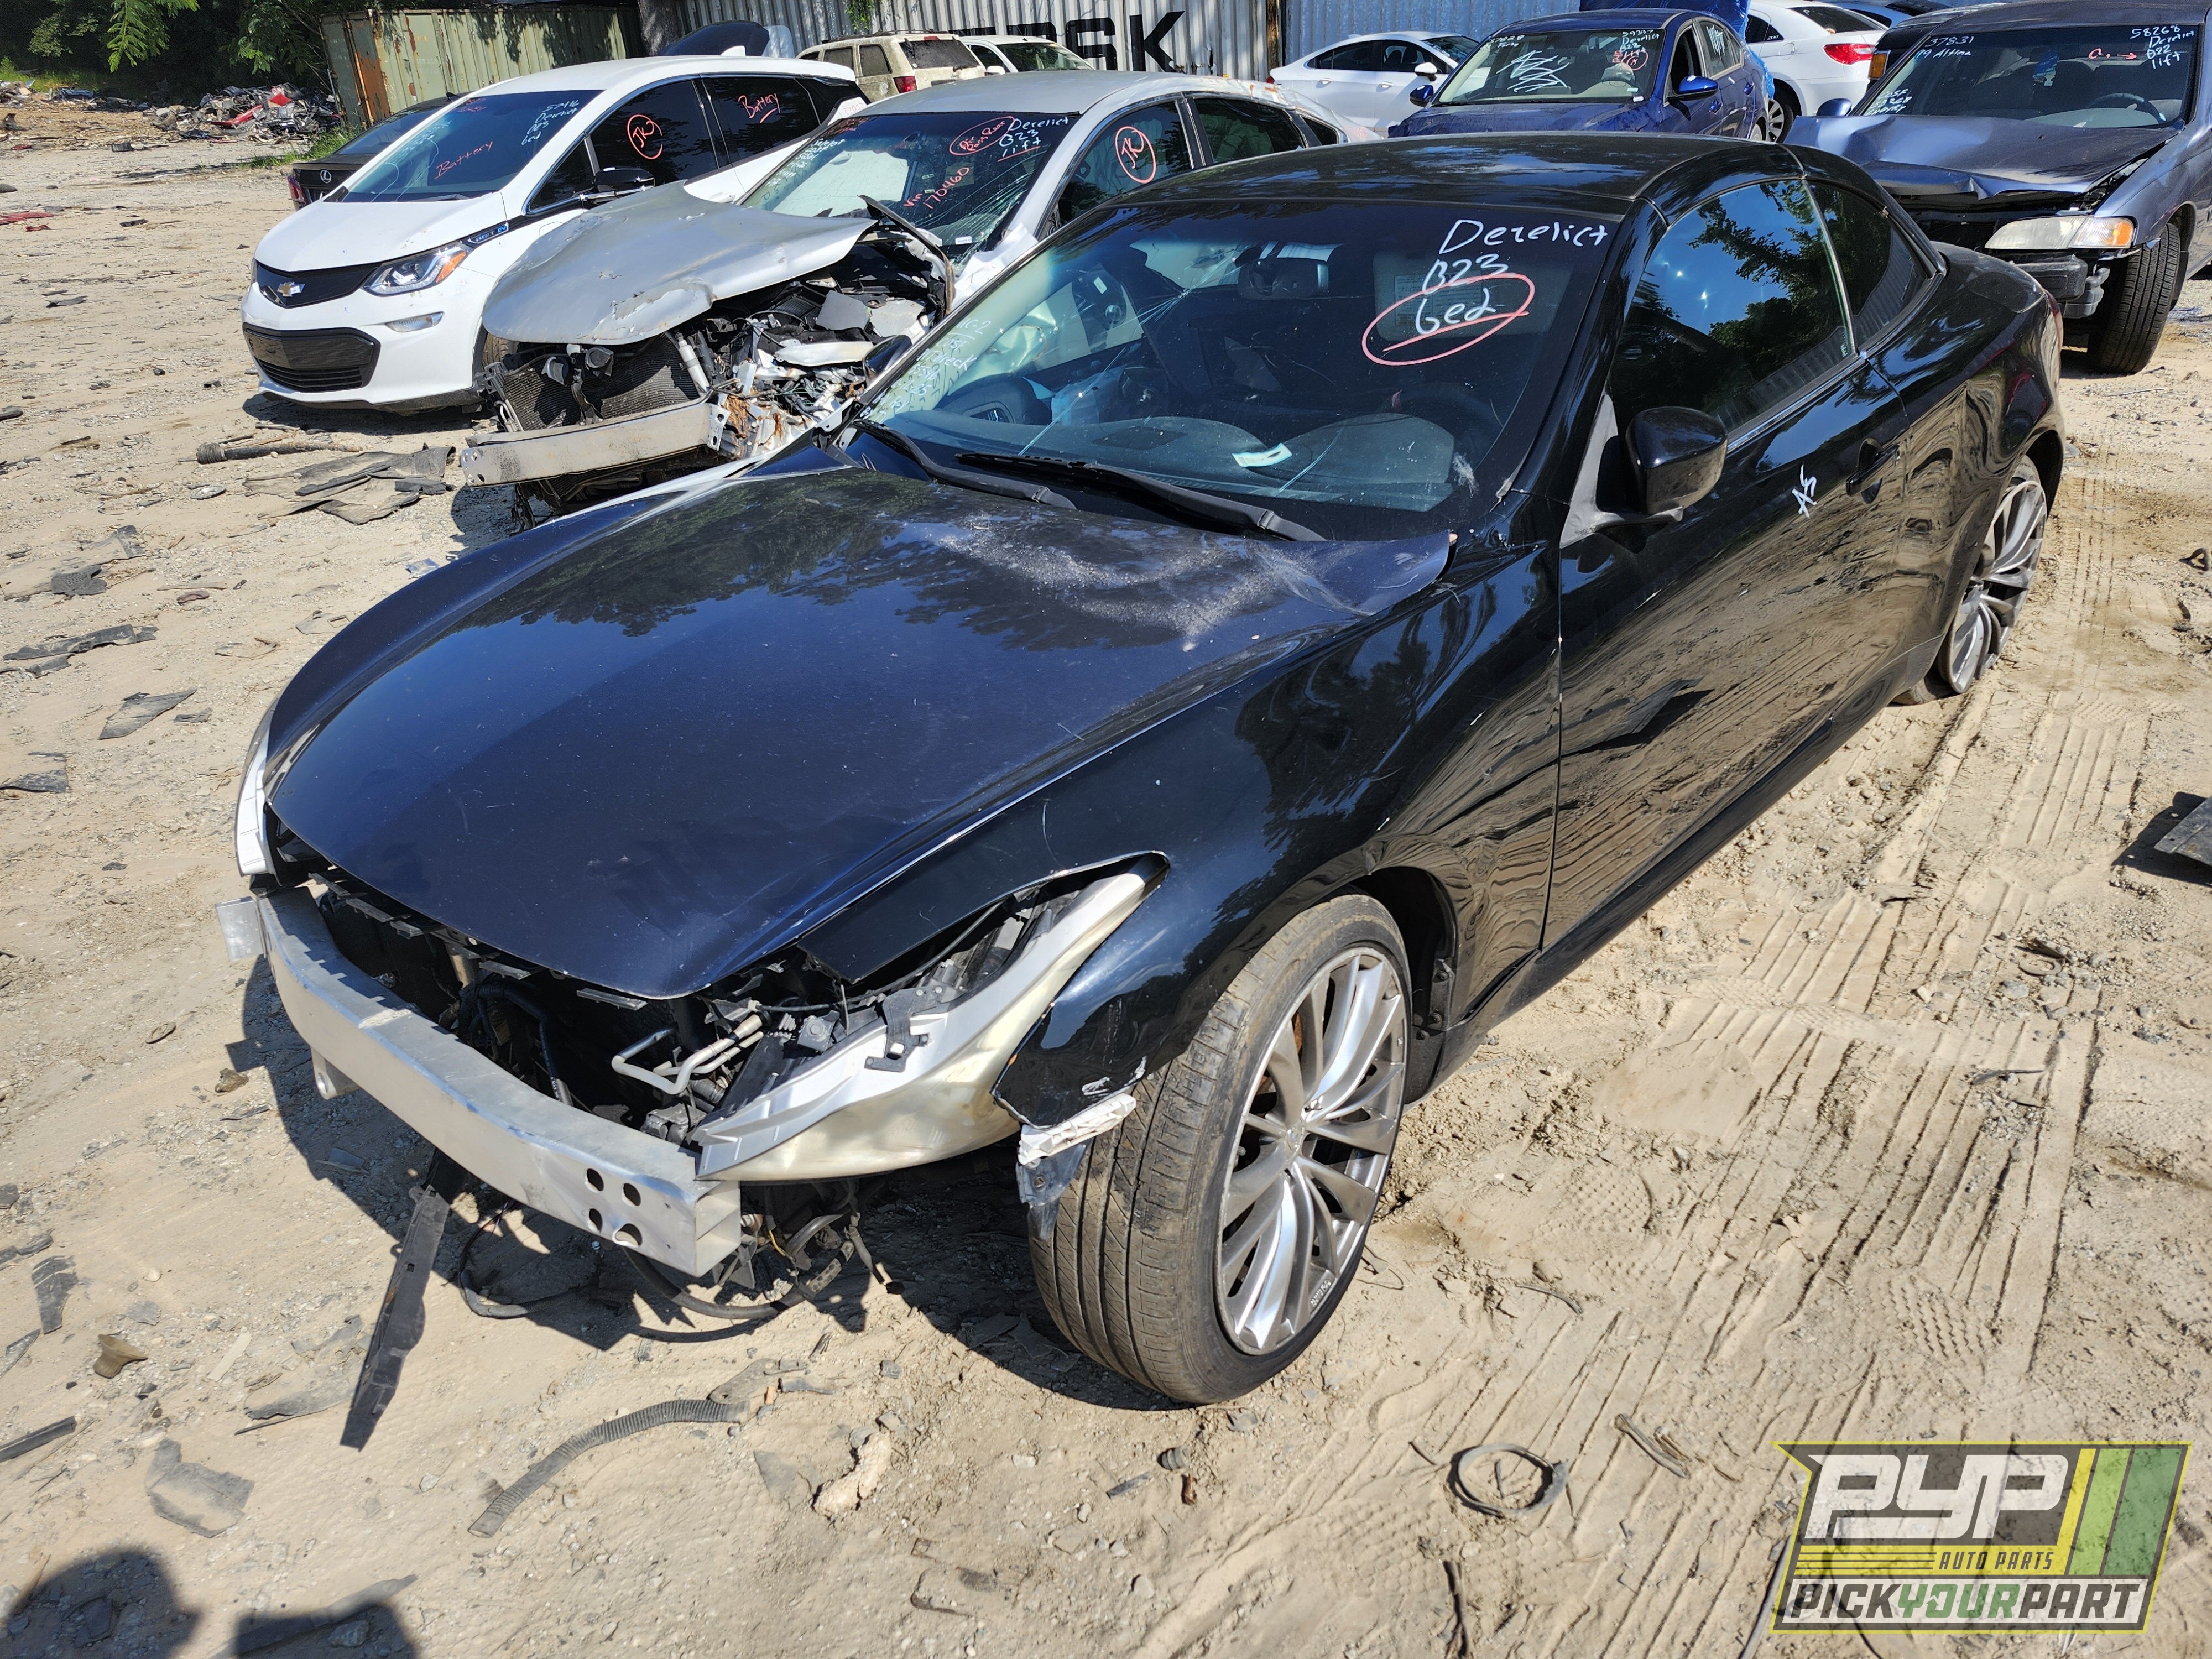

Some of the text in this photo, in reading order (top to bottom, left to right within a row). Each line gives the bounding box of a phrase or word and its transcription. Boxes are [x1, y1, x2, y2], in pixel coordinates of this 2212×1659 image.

[2130, 24, 2180, 39] 58268
[1924, 36, 1974, 48] 37831
[738, 93, 781, 118] Battery
[1008, 117, 1070, 131] Derelict
[1002, 138, 1041, 157] lift
[434, 141, 494, 179] Battery
[1439, 220, 1608, 254] Derelict
